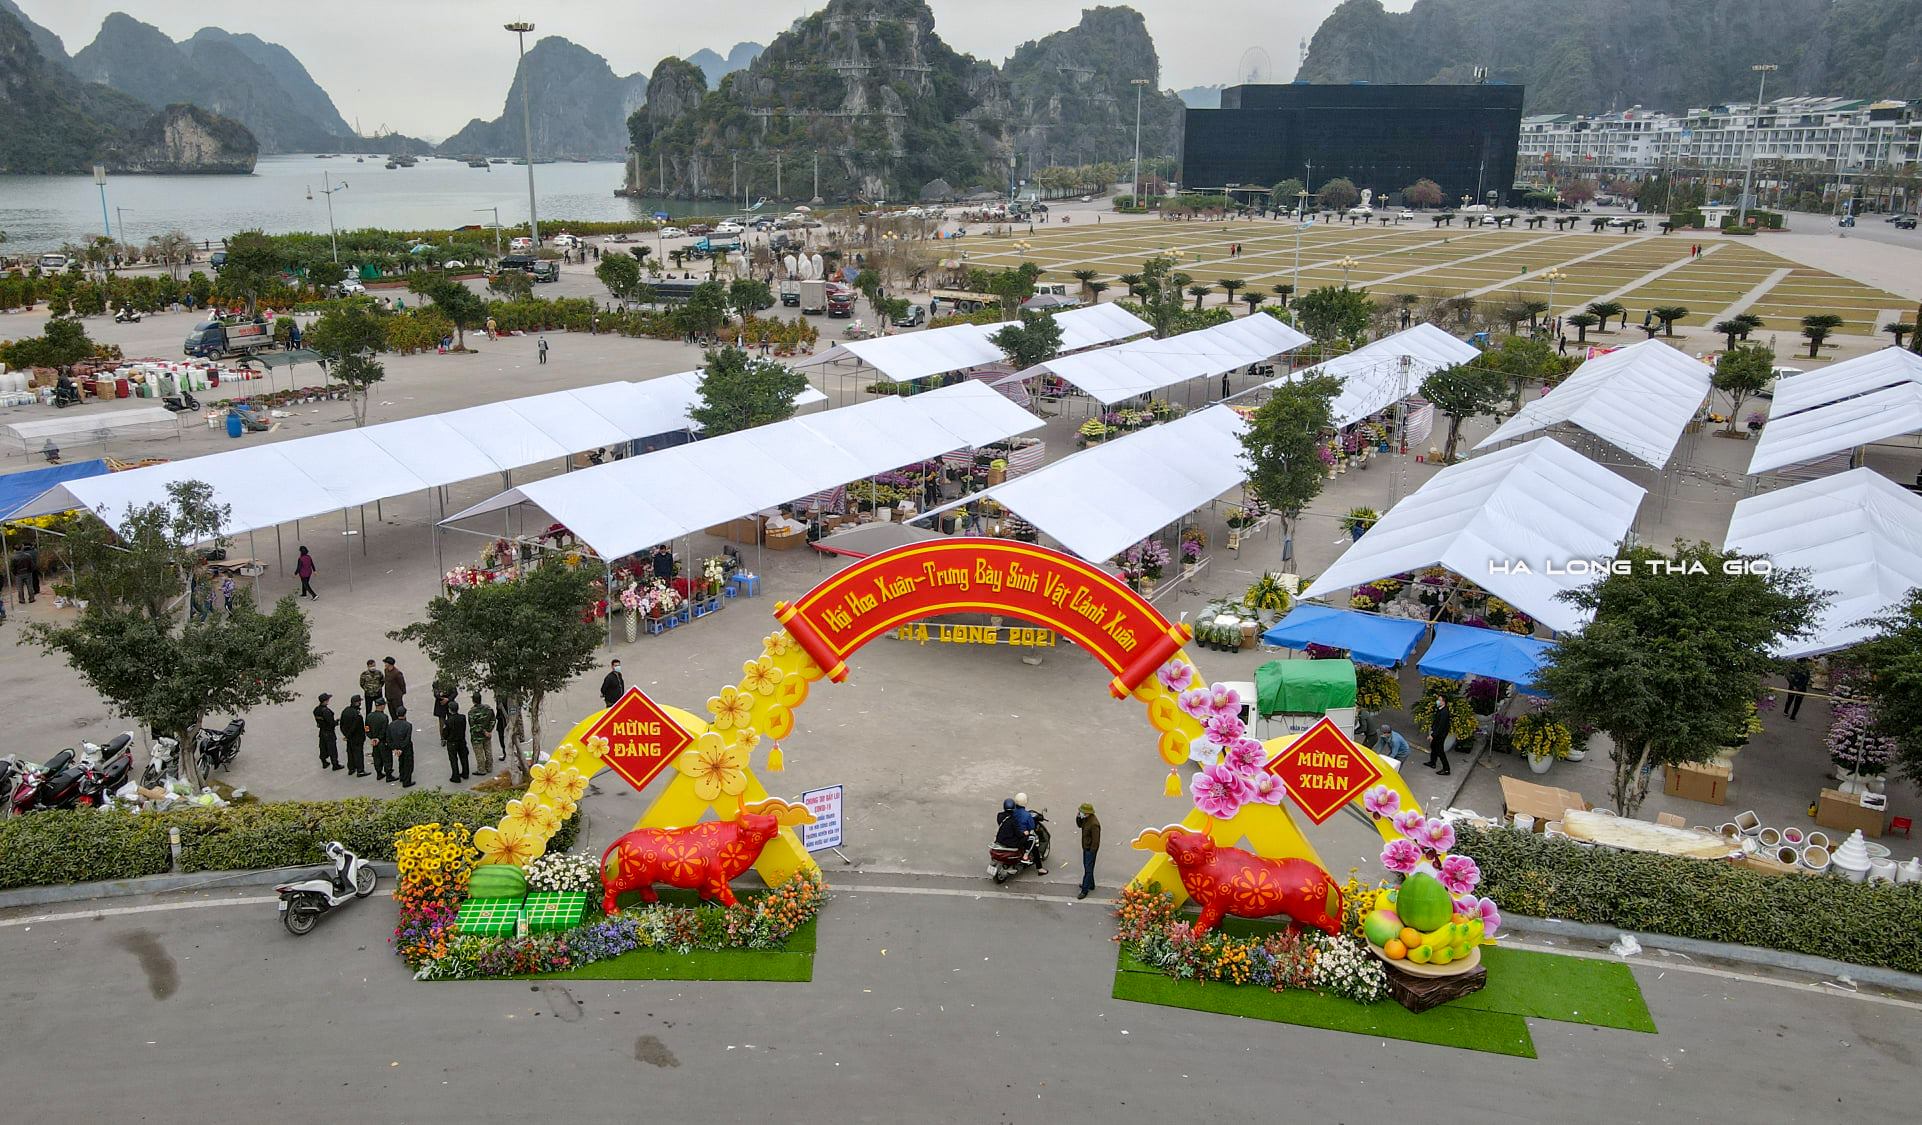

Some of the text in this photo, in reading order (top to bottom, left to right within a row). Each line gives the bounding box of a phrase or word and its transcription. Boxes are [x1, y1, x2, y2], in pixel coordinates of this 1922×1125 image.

[820, 604, 853, 634] Hội
[843, 590, 879, 618] Hoa
[974, 558, 1003, 593] Bày
[1006, 561, 1040, 593] Sinh
[1043, 571, 1073, 610] Vật
[1102, 610, 1139, 653] Xuân
[939, 625, 997, 645] LONG
[1008, 629, 1056, 647] 2021
[613, 718, 661, 735] MỪNG
[613, 739, 661, 757] ĐẢNG
[1297, 750, 1349, 769] MỪNG
[1299, 772, 1348, 790] XUÂN
